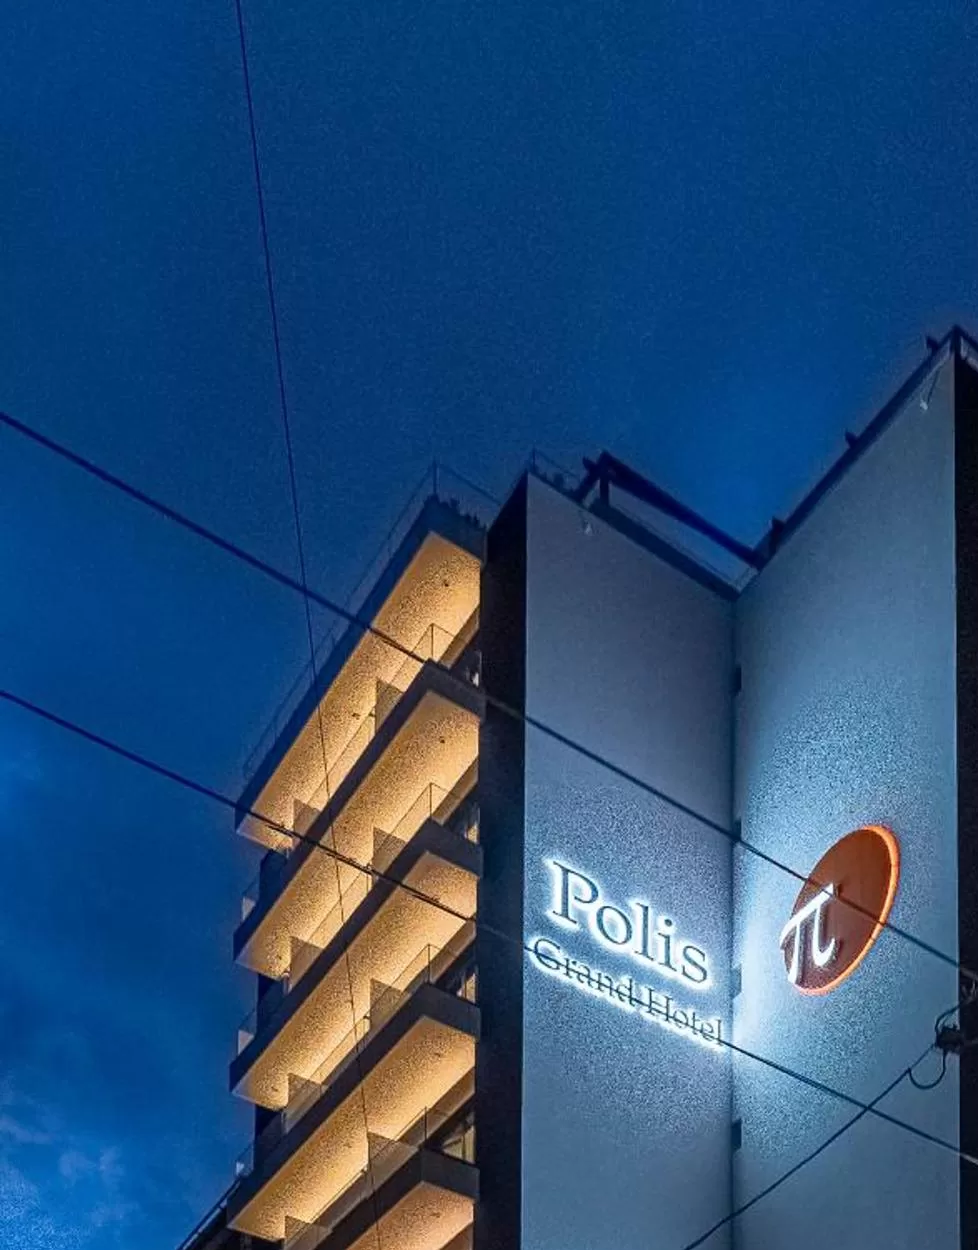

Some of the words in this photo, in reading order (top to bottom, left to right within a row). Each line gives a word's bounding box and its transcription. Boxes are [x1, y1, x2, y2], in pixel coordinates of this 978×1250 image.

[548, 859, 709, 985] Polis
[531, 937, 637, 1007] Grand
[644, 987, 725, 1047] Hotel
